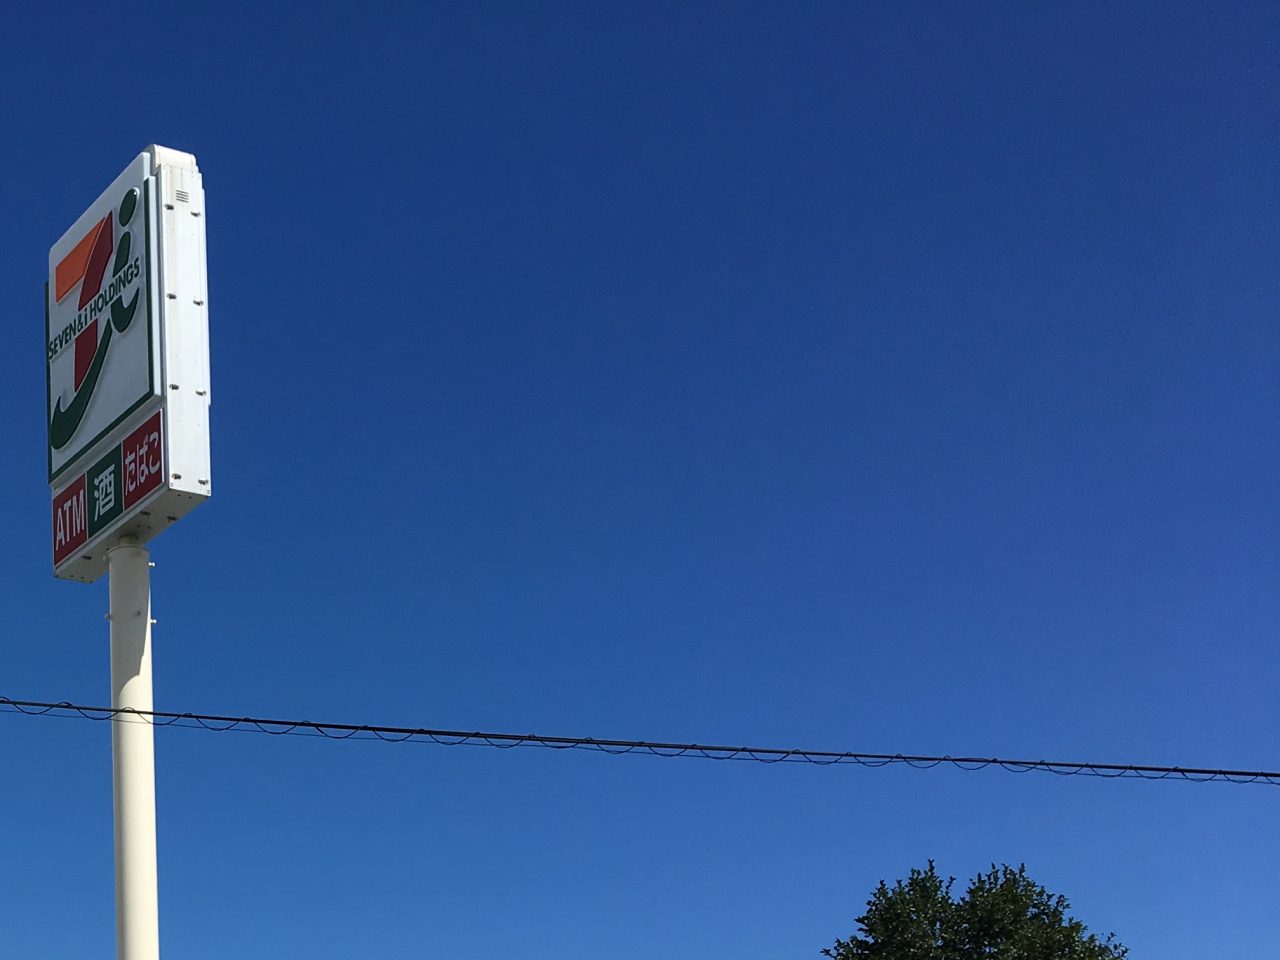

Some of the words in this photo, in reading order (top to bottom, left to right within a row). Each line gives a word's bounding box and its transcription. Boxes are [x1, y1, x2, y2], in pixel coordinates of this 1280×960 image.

[93, 463, 116, 522] 酒
[124, 431, 160, 496] たばこ
[56, 489, 85, 551] ATM
